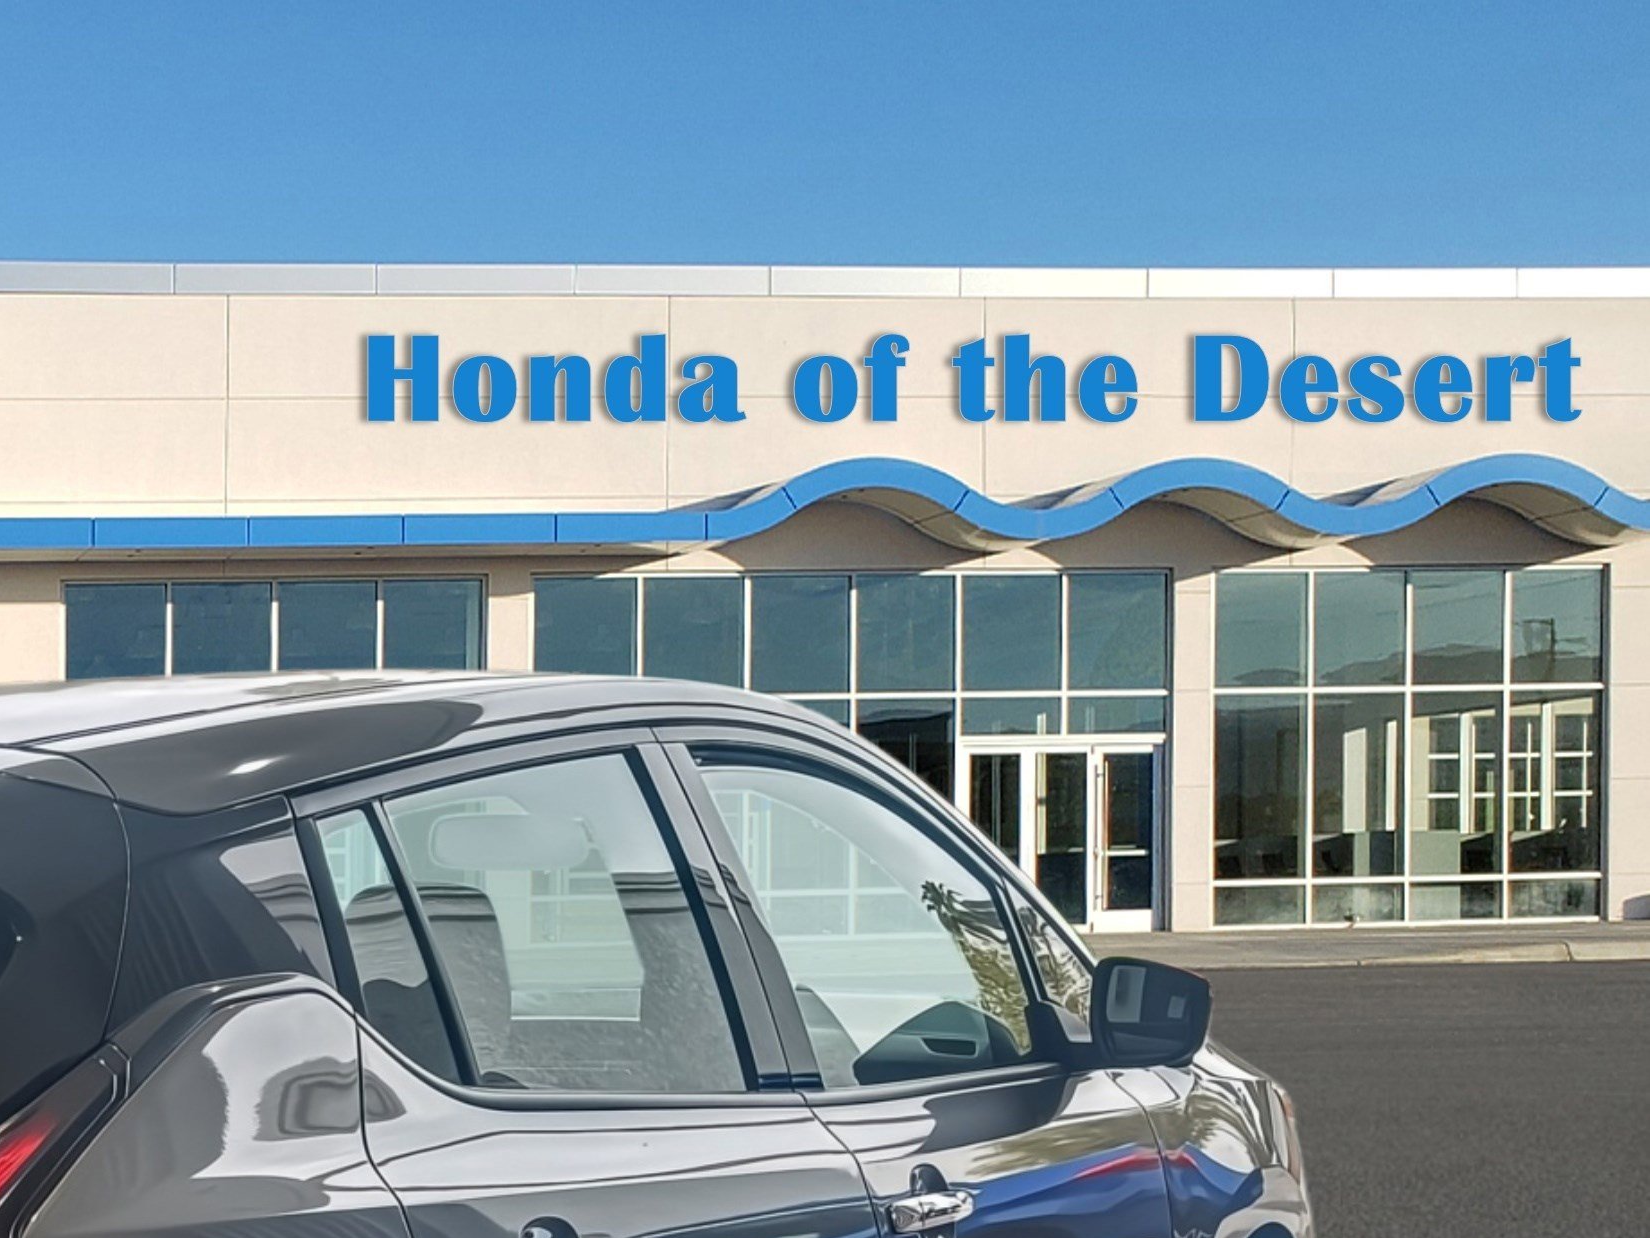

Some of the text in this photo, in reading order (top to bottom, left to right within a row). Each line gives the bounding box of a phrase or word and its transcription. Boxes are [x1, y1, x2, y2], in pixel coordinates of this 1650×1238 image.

[366, 334, 1583, 423] Honda of the Desert
